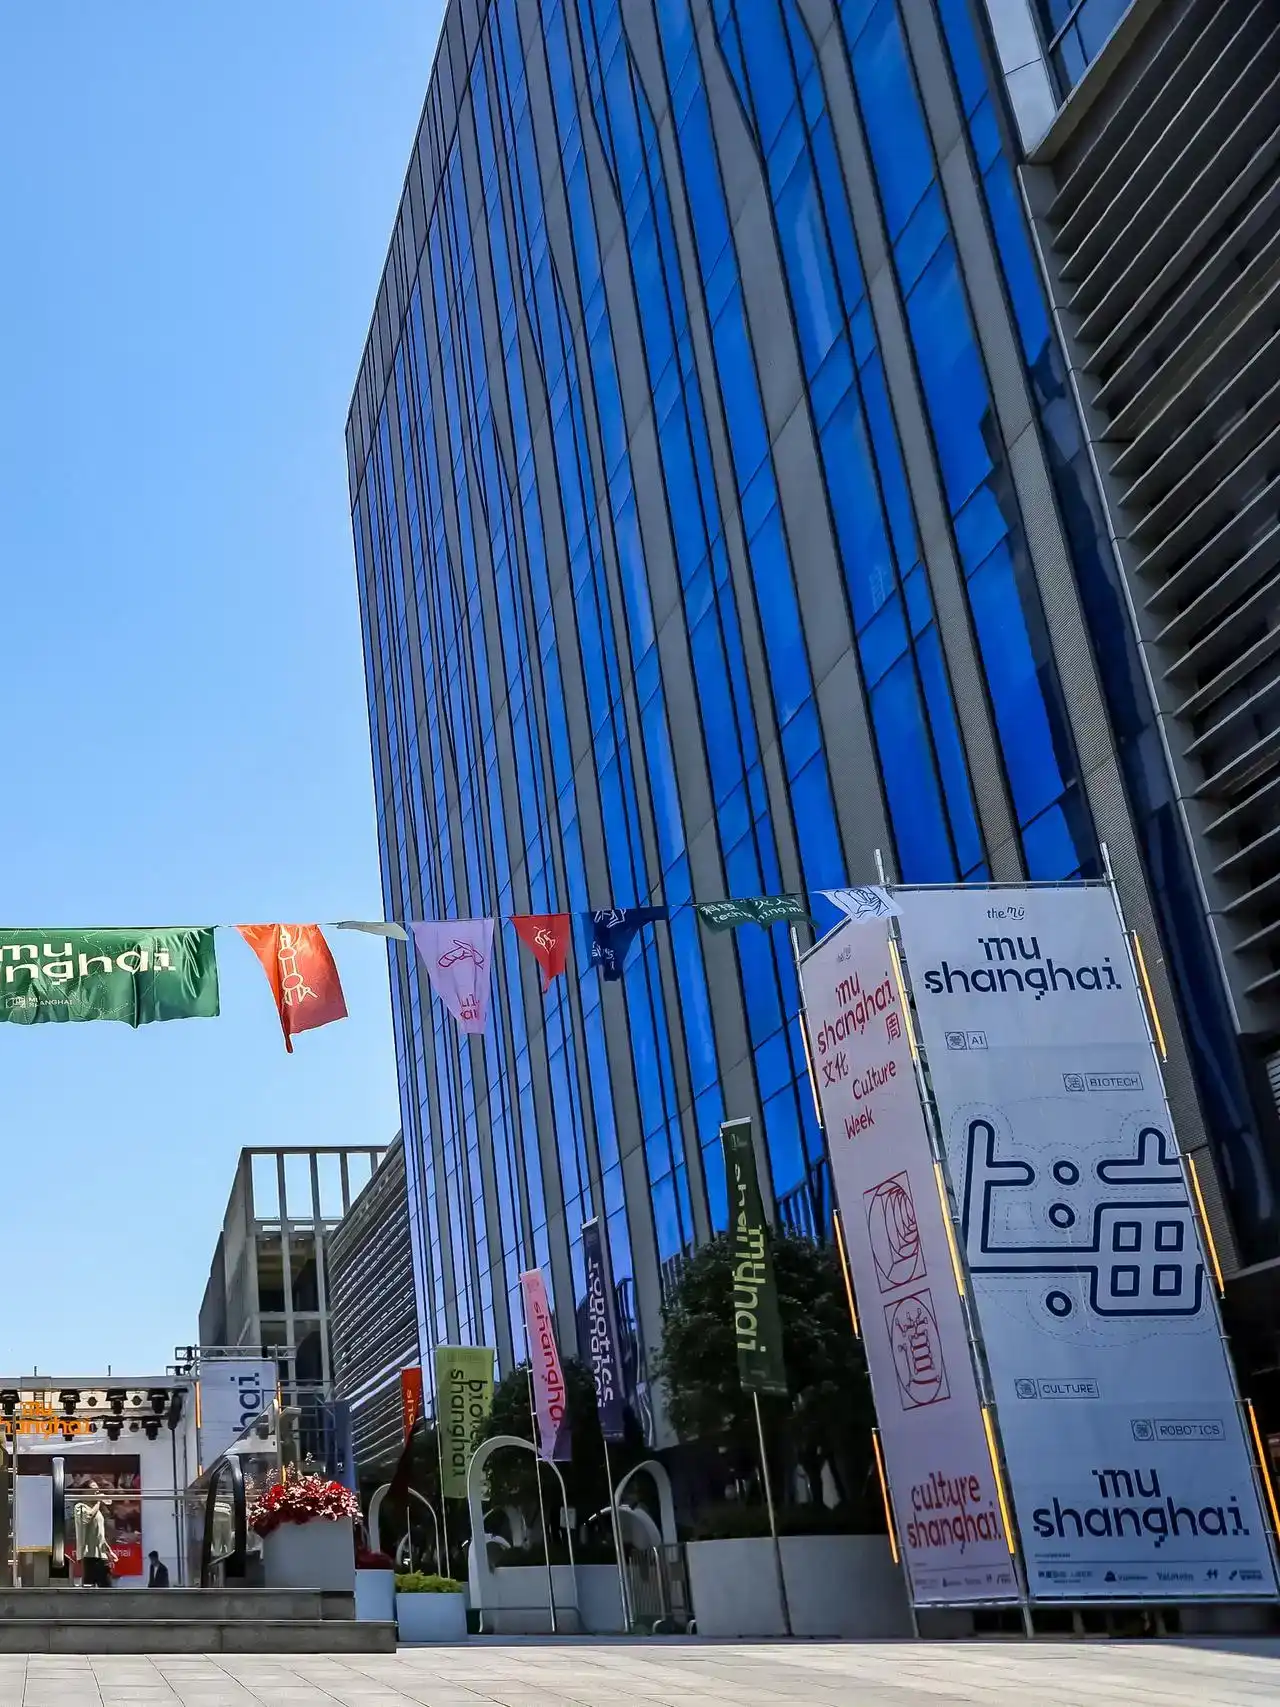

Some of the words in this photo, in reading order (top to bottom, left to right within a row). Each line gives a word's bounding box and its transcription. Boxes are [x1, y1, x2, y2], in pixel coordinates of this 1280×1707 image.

[986, 906, 1006, 920] the
[978, 935, 1041, 961] mu
[835, 971, 861, 1008] mu
[924, 957, 1122, 1000] shanghai
[817, 970, 895, 1055] shanghai
[885, 1012, 902, 1045] 周
[971, 1035, 984, 1046] AI
[822, 1051, 849, 1088] 文化
[1089, 1077, 1139, 1087] BIOTECH
[844, 1105, 875, 1140] Week
[1042, 1383, 1095, 1394] CULTURE
[1159, 1424, 1221, 1436] ROBOTICS
[910, 1471, 981, 1512] culture
[1091, 1467, 1161, 1499] mu
[907, 1505, 1003, 1555] shanghai
[1032, 1495, 1251, 1549] shanghai
